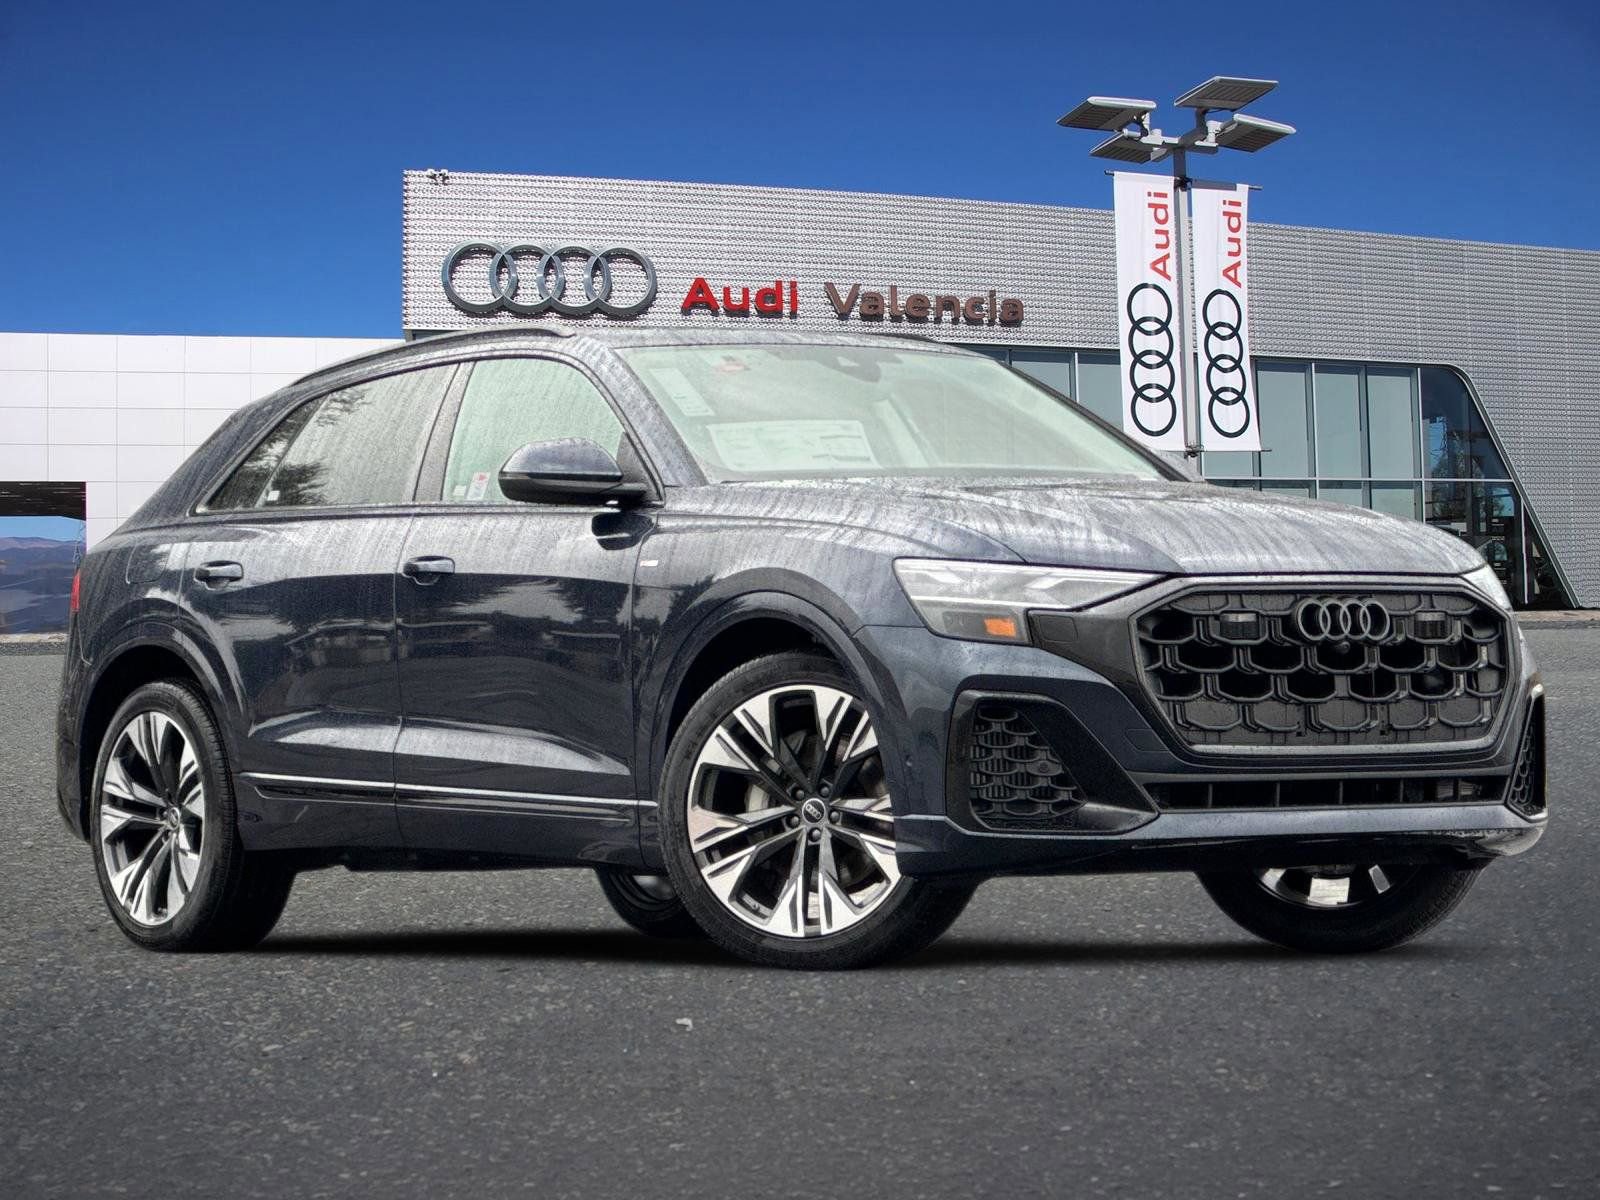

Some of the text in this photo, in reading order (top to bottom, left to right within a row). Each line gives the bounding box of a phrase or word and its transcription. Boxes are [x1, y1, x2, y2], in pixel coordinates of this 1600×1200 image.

[1147, 190, 1172, 281] Audi
[1222, 199, 1242, 288] Audi
[681, 277, 1025, 325] Audi Valencia
